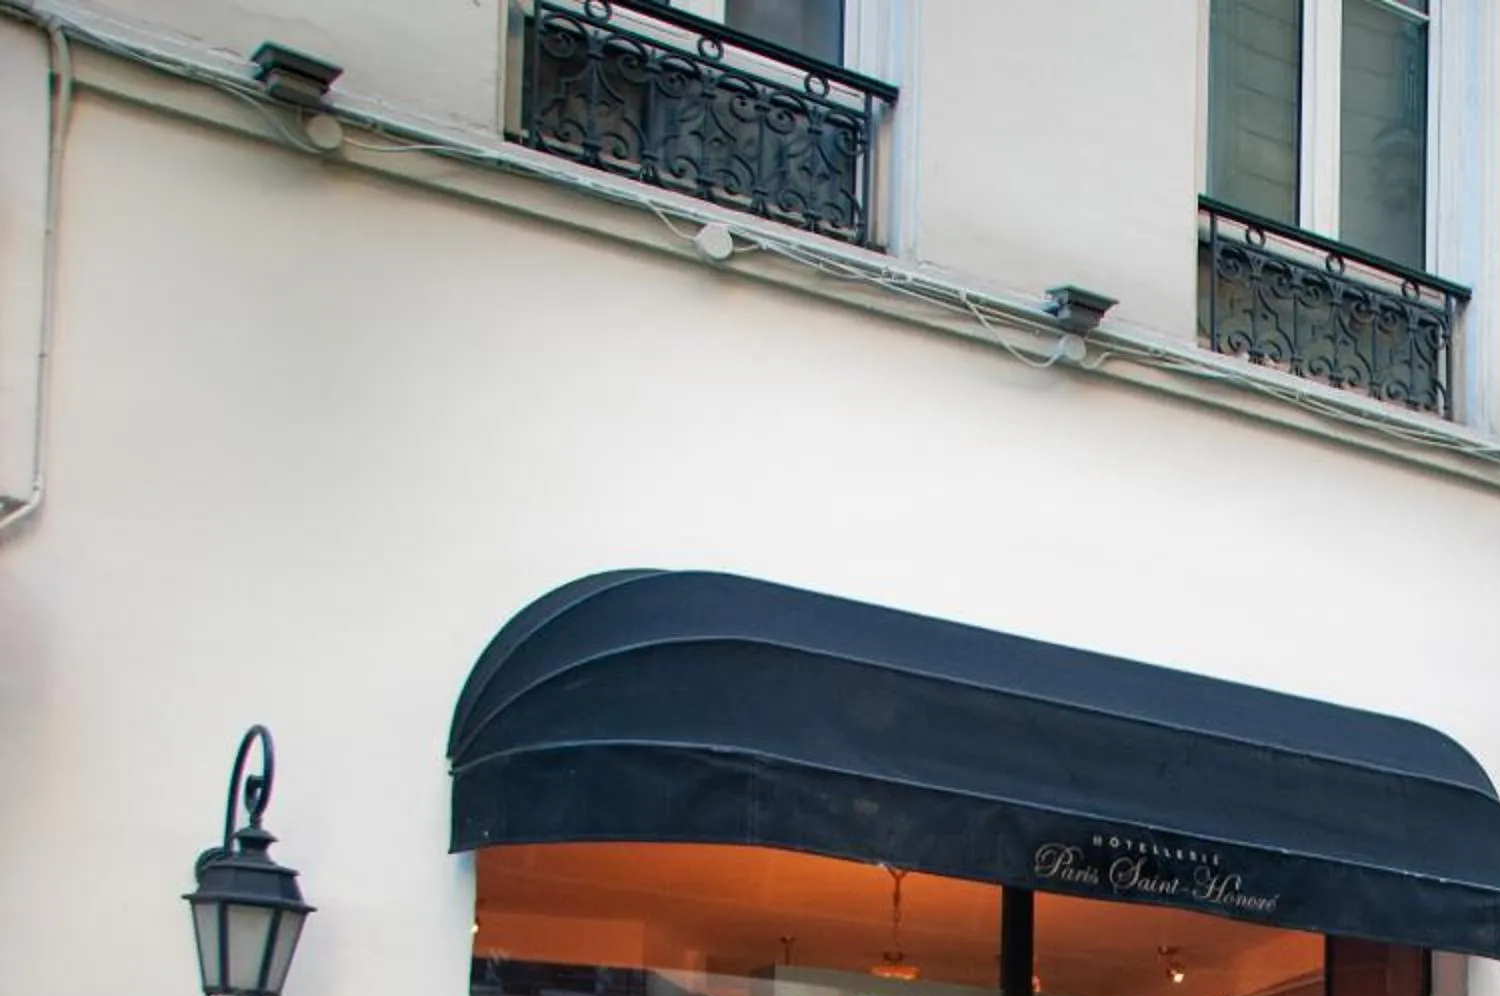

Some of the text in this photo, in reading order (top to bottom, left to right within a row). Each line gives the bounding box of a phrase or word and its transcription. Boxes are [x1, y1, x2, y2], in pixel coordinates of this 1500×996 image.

[1091, 833, 1222, 867] HOTELLERIE
[1034, 841, 1281, 912] Paris Saint-Honoré
